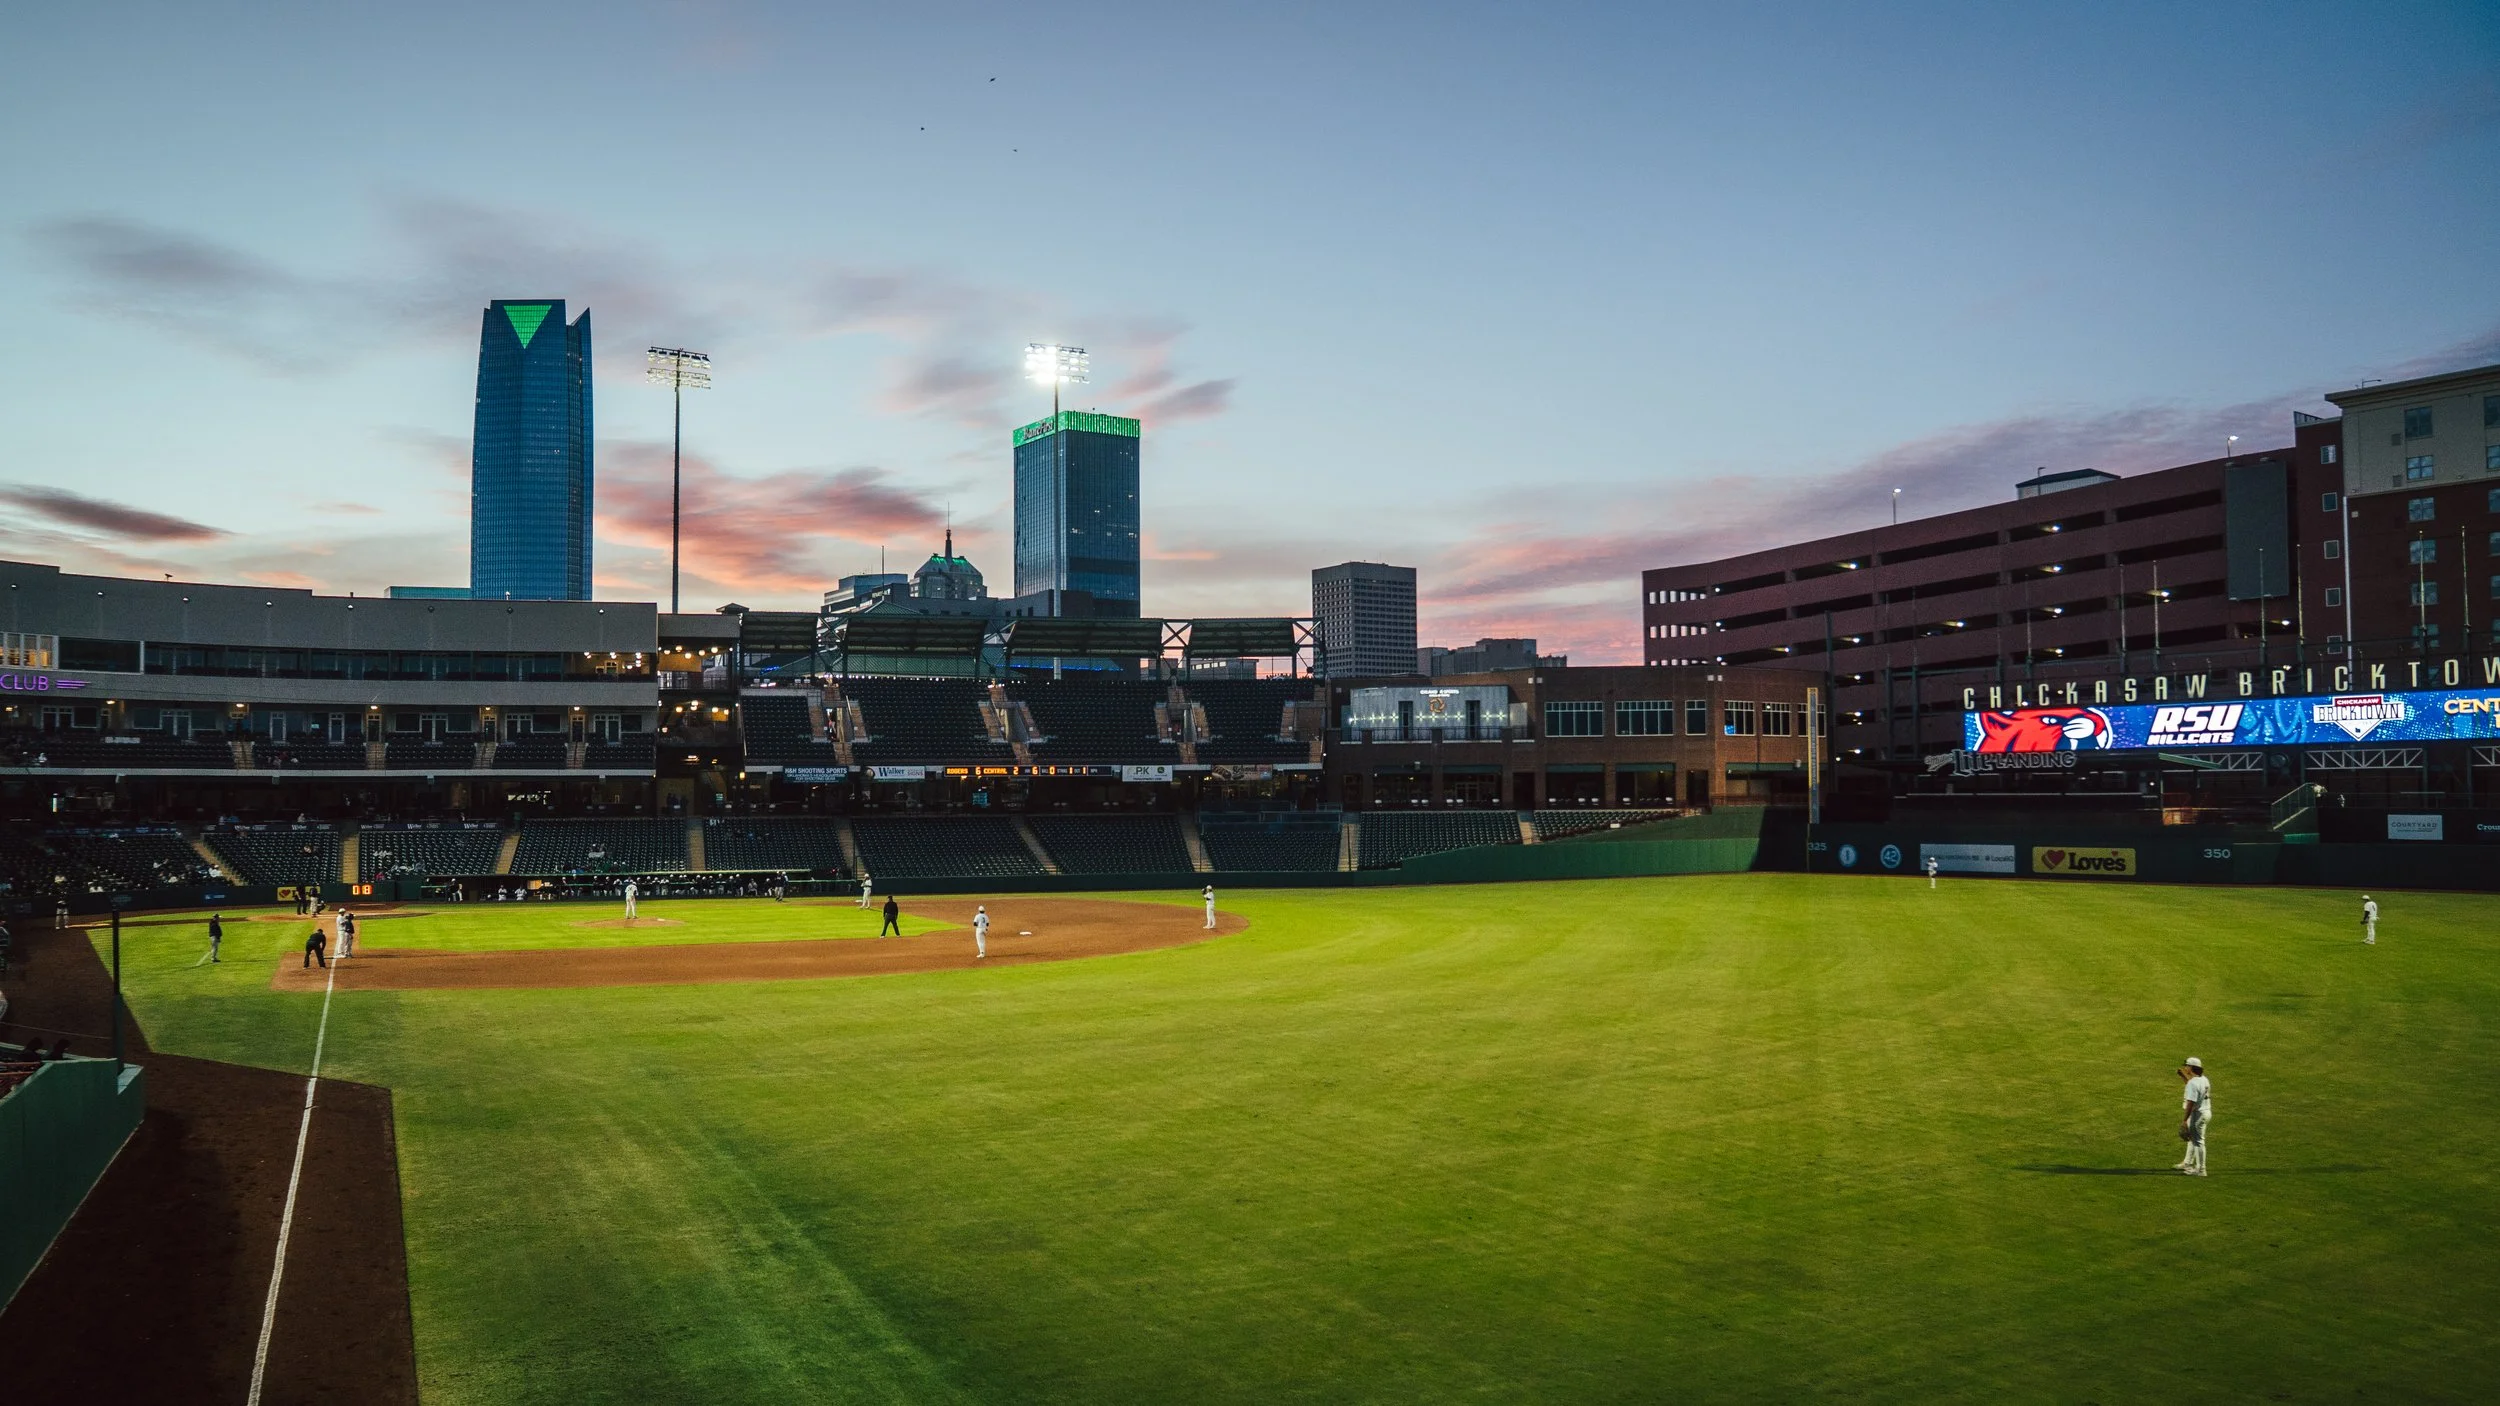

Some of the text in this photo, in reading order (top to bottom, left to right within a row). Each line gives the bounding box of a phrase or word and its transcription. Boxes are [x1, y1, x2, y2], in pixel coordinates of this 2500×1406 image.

[0, 673, 49, 691] CLUB
[1963, 674, 2207, 710] CHICKASAW
[2336, 698, 2380, 706] CHICKASAW
[2317, 703, 2401, 721] BRICKTOWN
[2150, 704, 2244, 733] RSU
[2146, 731, 2235, 746] HILLCATS
[1995, 752, 2077, 768] LANDING
[976, 766, 981, 775] 6
[1013, 766, 1019, 775] 2
[1032, 766, 1039, 775] 6
[1049, 766, 1056, 775] 0
[1807, 842, 1828, 851] 325
[1884, 850, 1897, 862] 42
[2204, 848, 2231, 859] 350
